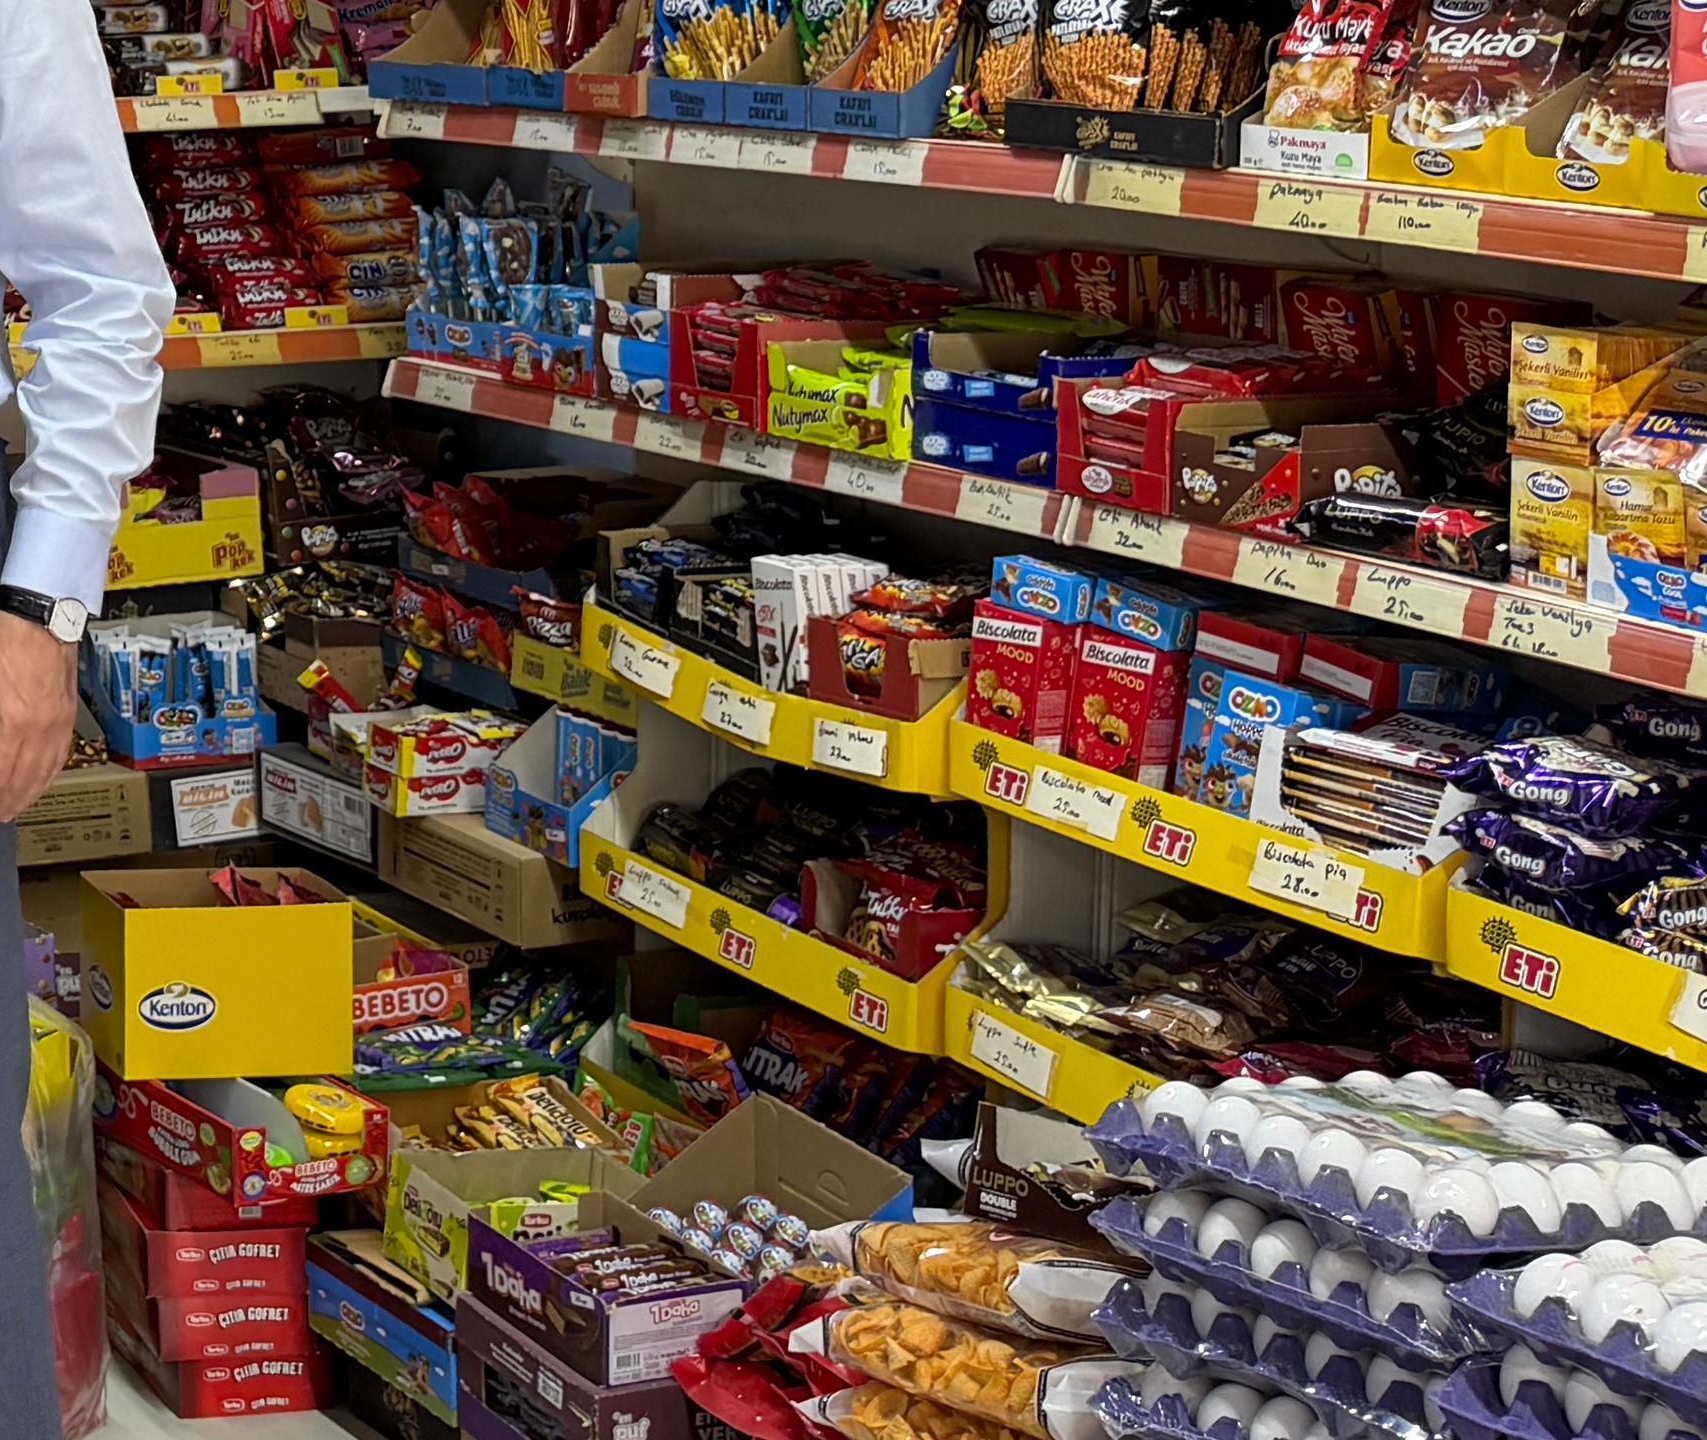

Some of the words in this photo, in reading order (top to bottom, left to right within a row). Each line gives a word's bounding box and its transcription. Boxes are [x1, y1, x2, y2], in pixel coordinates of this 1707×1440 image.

[1433, 0, 1489, 15] Kenton
[1424, 26, 1538, 59] Kakao
[1279, 136, 1326, 150] Pakmaya
[772, 403, 830, 435] Nutymax
[973, 618, 1039, 645] Biscolata
[995, 643, 1034, 664] MOOD
[1084, 640, 1152, 669] Biscolata
[1107, 668, 1145, 692] MOOD
[1509, 779, 1569, 807] Gong
[1495, 844, 1545, 875] Gong
[149, 997, 209, 1019] Kenton
[353, 981, 448, 1022] BEBETO
[238, 1243, 280, 1258] GOFRET
